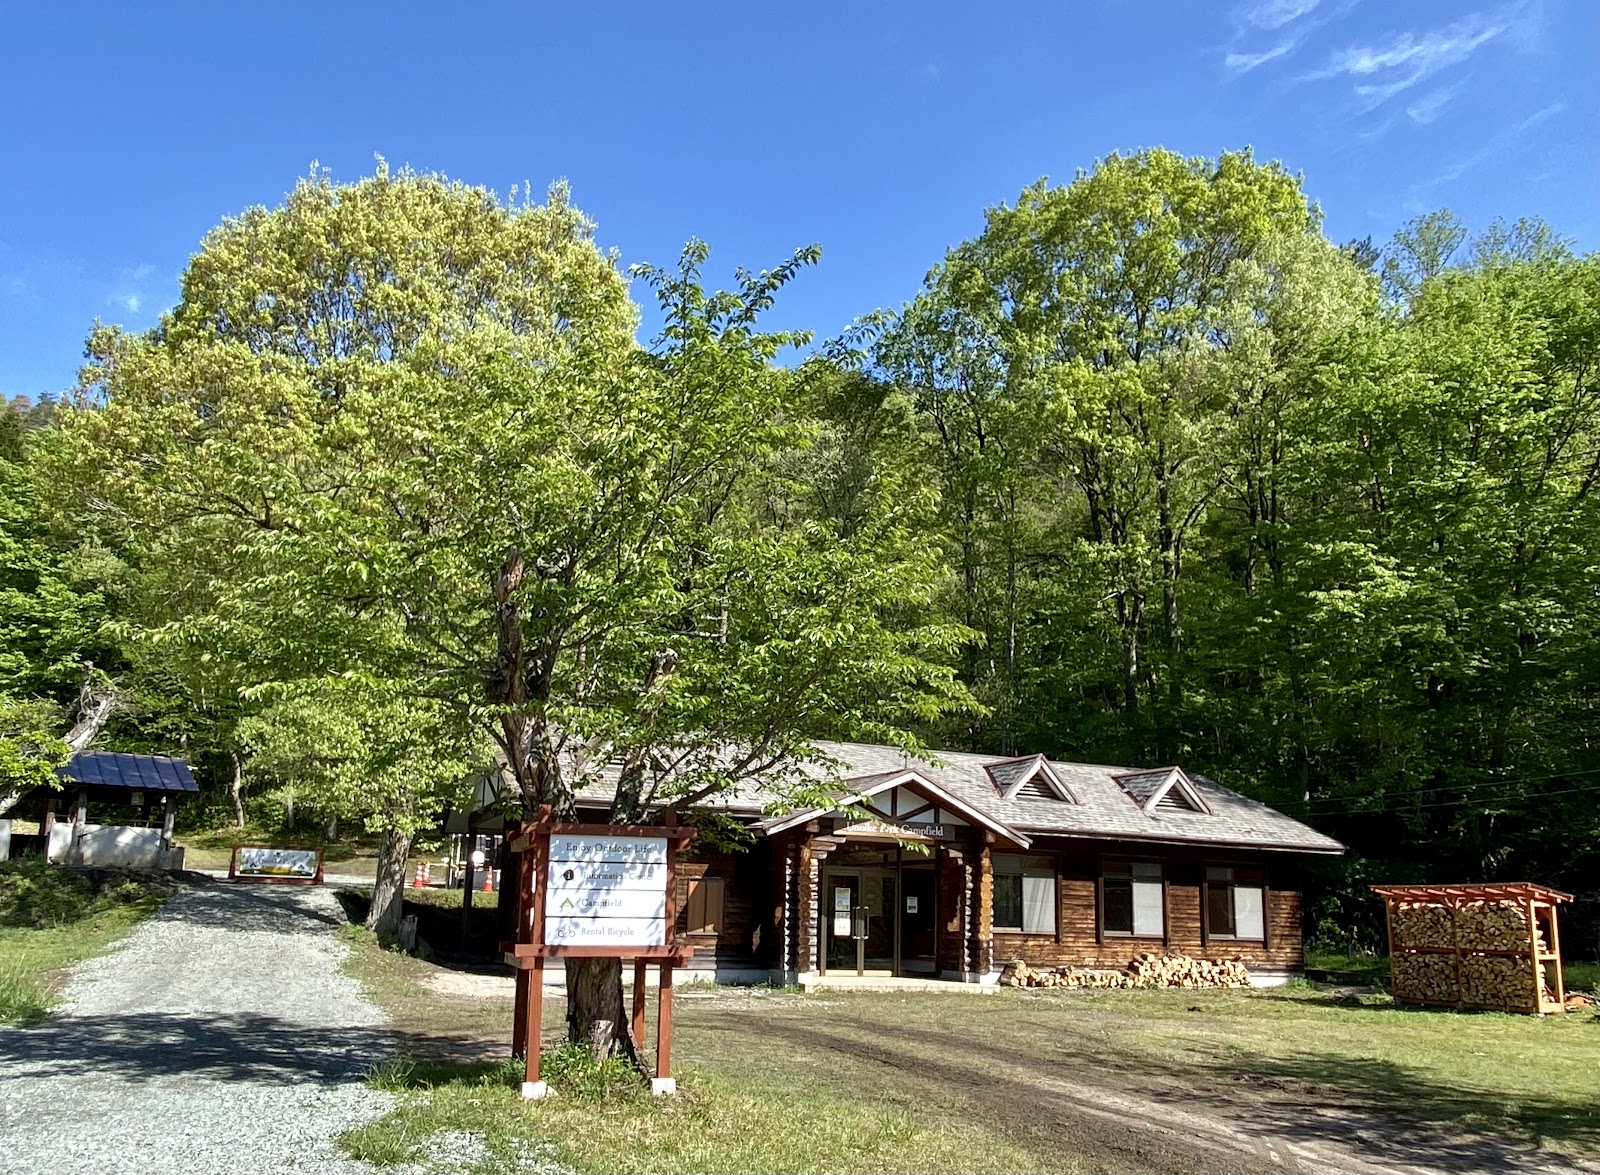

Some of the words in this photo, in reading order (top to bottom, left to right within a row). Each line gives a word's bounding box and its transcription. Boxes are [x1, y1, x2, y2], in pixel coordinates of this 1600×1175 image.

[880, 823, 899, 834] Park
[901, 824, 944, 837] Campfield
[566, 842, 591, 853] Enjoy
[595, 843, 632, 853] Outdoor
[634, 844, 652, 853] Life
[583, 870, 627, 879] Information
[581, 898, 622, 908] Campfield
[581, 927, 605, 935] Rental
[607, 927, 635, 937] Bicycle
